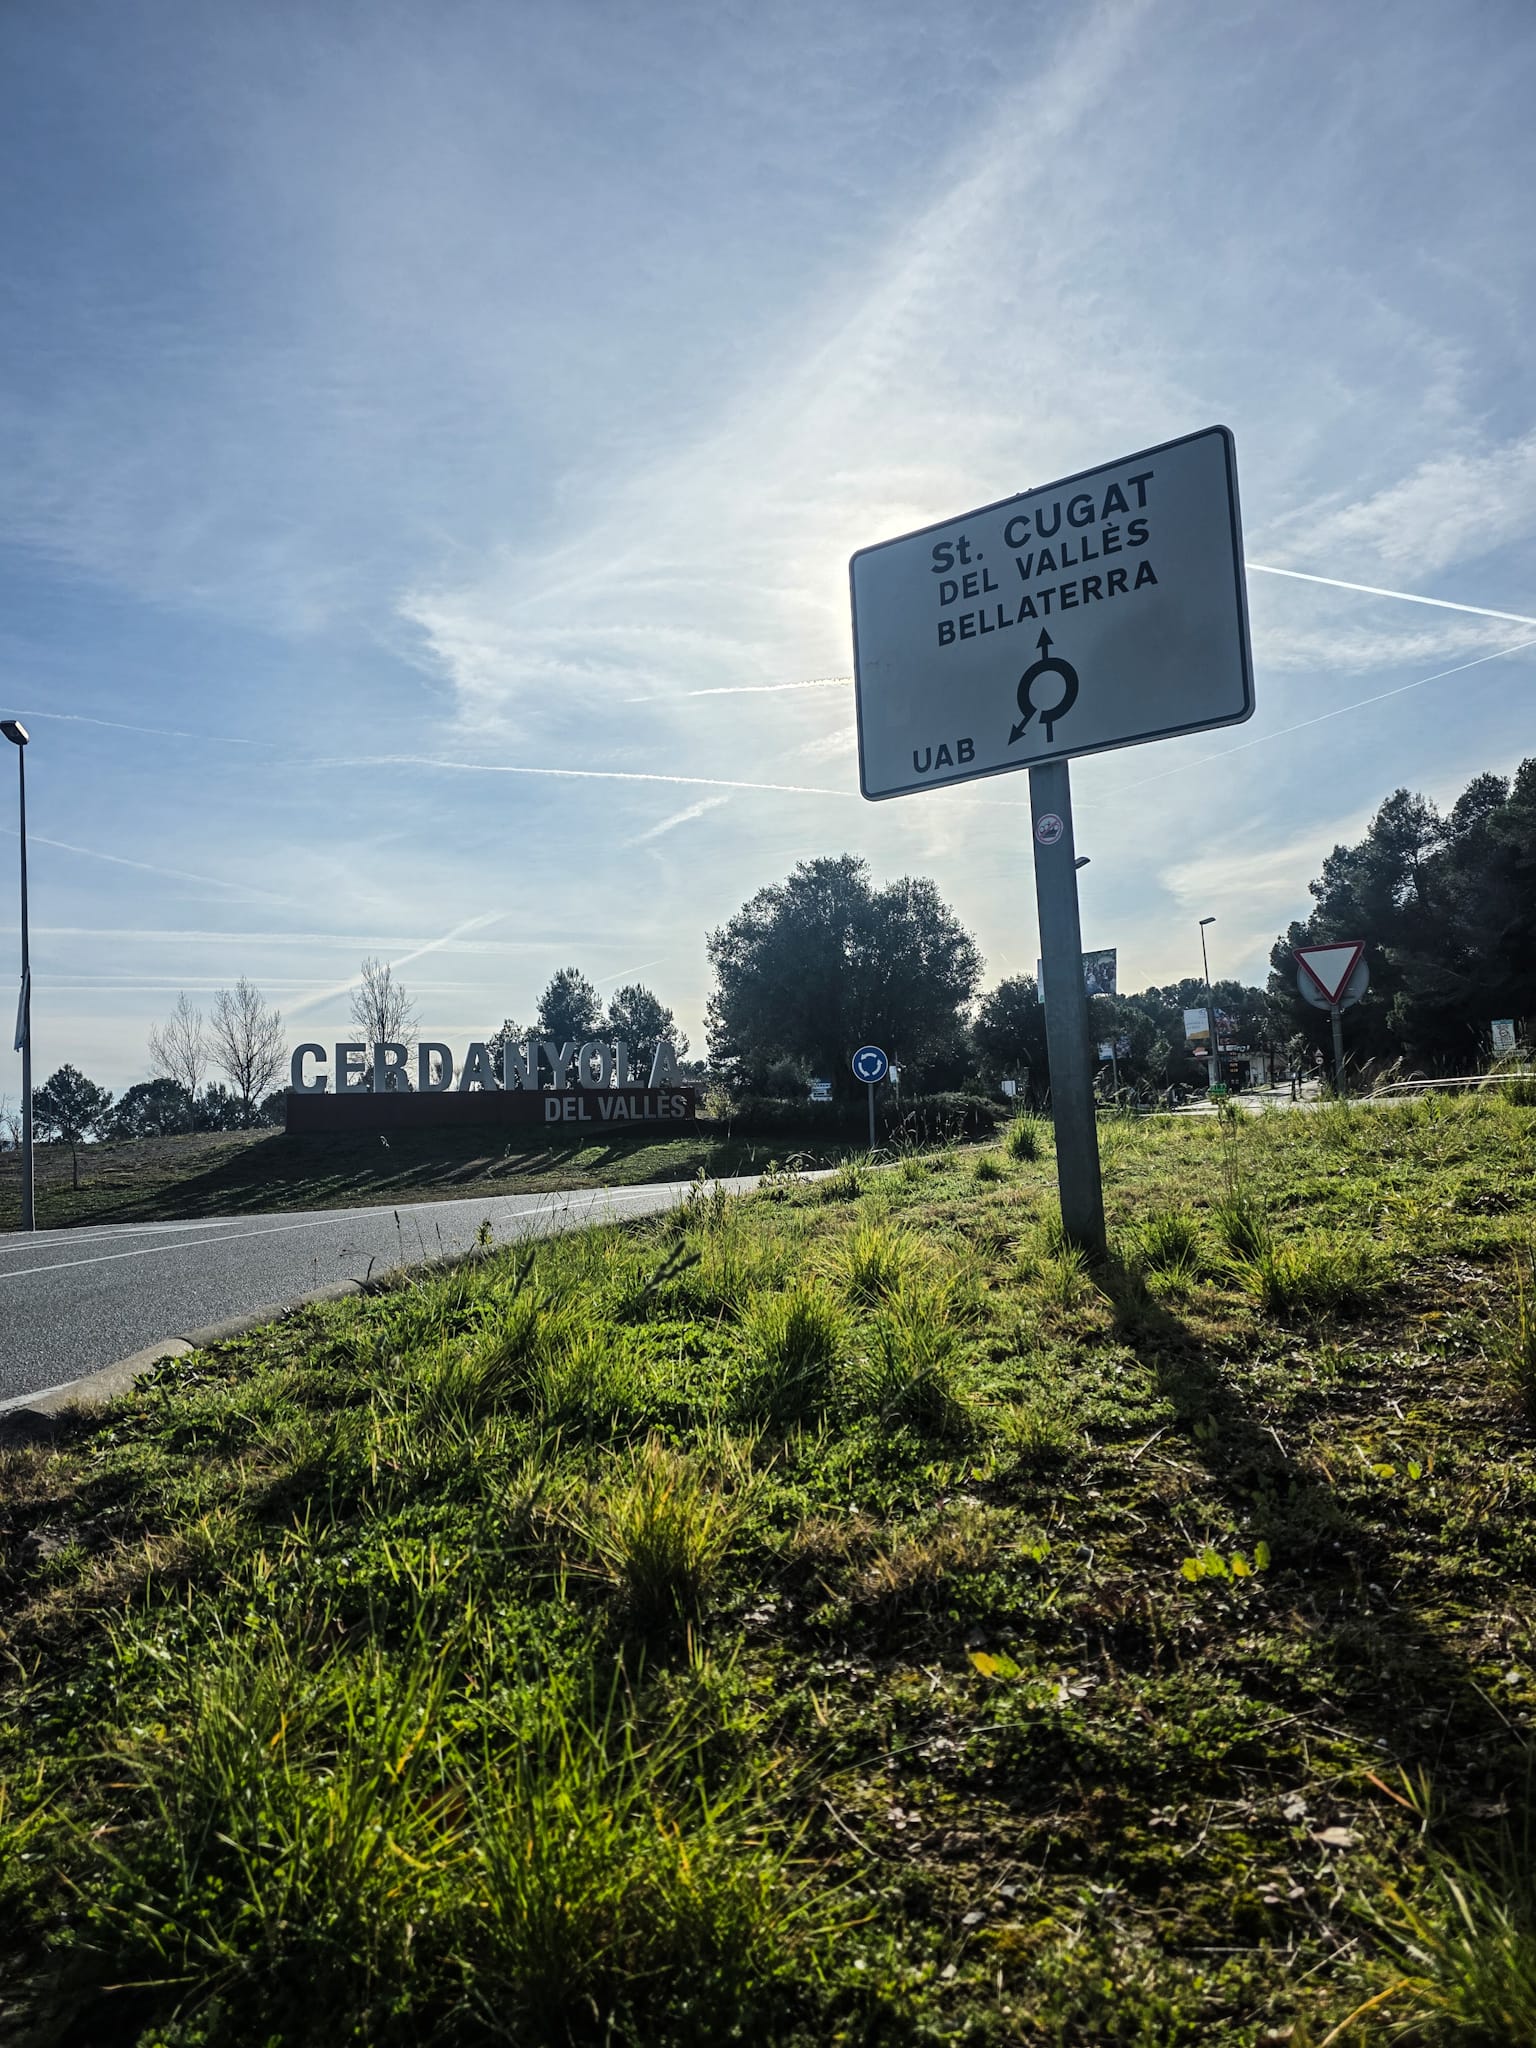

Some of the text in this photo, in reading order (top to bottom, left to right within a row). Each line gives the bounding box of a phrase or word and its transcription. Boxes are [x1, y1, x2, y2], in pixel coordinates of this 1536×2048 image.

[931, 471, 1154, 574] St. CUGAT
[939, 519, 1150, 606] DEL VALLÈS
[937, 560, 1158, 647] BELLATERRA
[913, 738, 975, 774] UAB
[290, 1041, 683, 1094] CERDANYOLA
[545, 1090, 687, 1122] DEL VALLÈS
